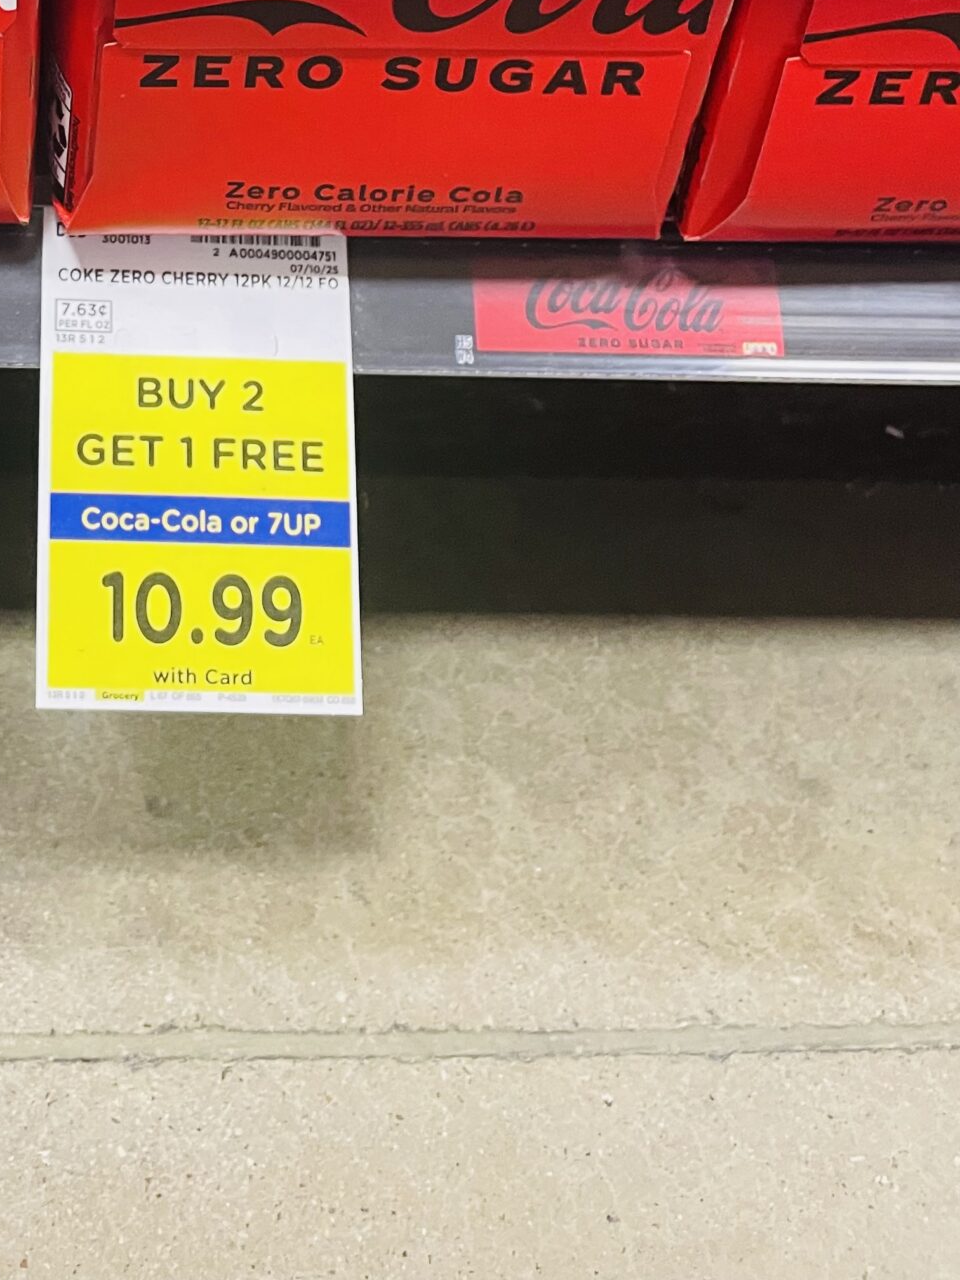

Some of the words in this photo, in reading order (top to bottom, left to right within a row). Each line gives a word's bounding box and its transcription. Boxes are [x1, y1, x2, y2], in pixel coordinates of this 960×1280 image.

[139, 54, 344, 90] ZERO
[380, 56, 646, 96] SUGAR
[815, 70, 960, 105] ZER
[225, 181, 301, 200] Zero
[314, 184, 435, 203] Calorie
[449, 186, 524, 204] Cola
[873, 196, 948, 213] Zero
[213, 248, 220, 257] 2
[58, 267, 104, 282] COKE
[110, 269, 155, 284] ZERO
[161, 271, 228, 287] CHERRY
[234, 274, 271, 288] 12PK
[277, 275, 313, 290] 12/12
[318, 277, 339, 290] FO
[290, 264, 338, 275] 07/10/25
[525, 270, 724, 333] CocaCola
[58, 319, 78, 329] PER
[80, 320, 92, 329] FL
[95, 320, 110, 330] OZ
[577, 337, 621, 349] ZERO
[628, 337, 684, 350] SUGAR
[138, 377, 225, 410] BUY
[242, 380, 264, 412] 2
[76, 434, 163, 466] GET
[180, 436, 193, 468] 1
[214, 438, 324, 472] FREE
[81, 506, 223, 534] Coca-Cola
[230, 514, 258, 534] or
[268, 512, 321, 536] 7UP
[102, 571, 302, 647] 10.99
[309, 635, 325, 645] EA
[153, 668, 197, 685] with
[206, 668, 253, 686] Card
[102, 691, 139, 701] Grocery
